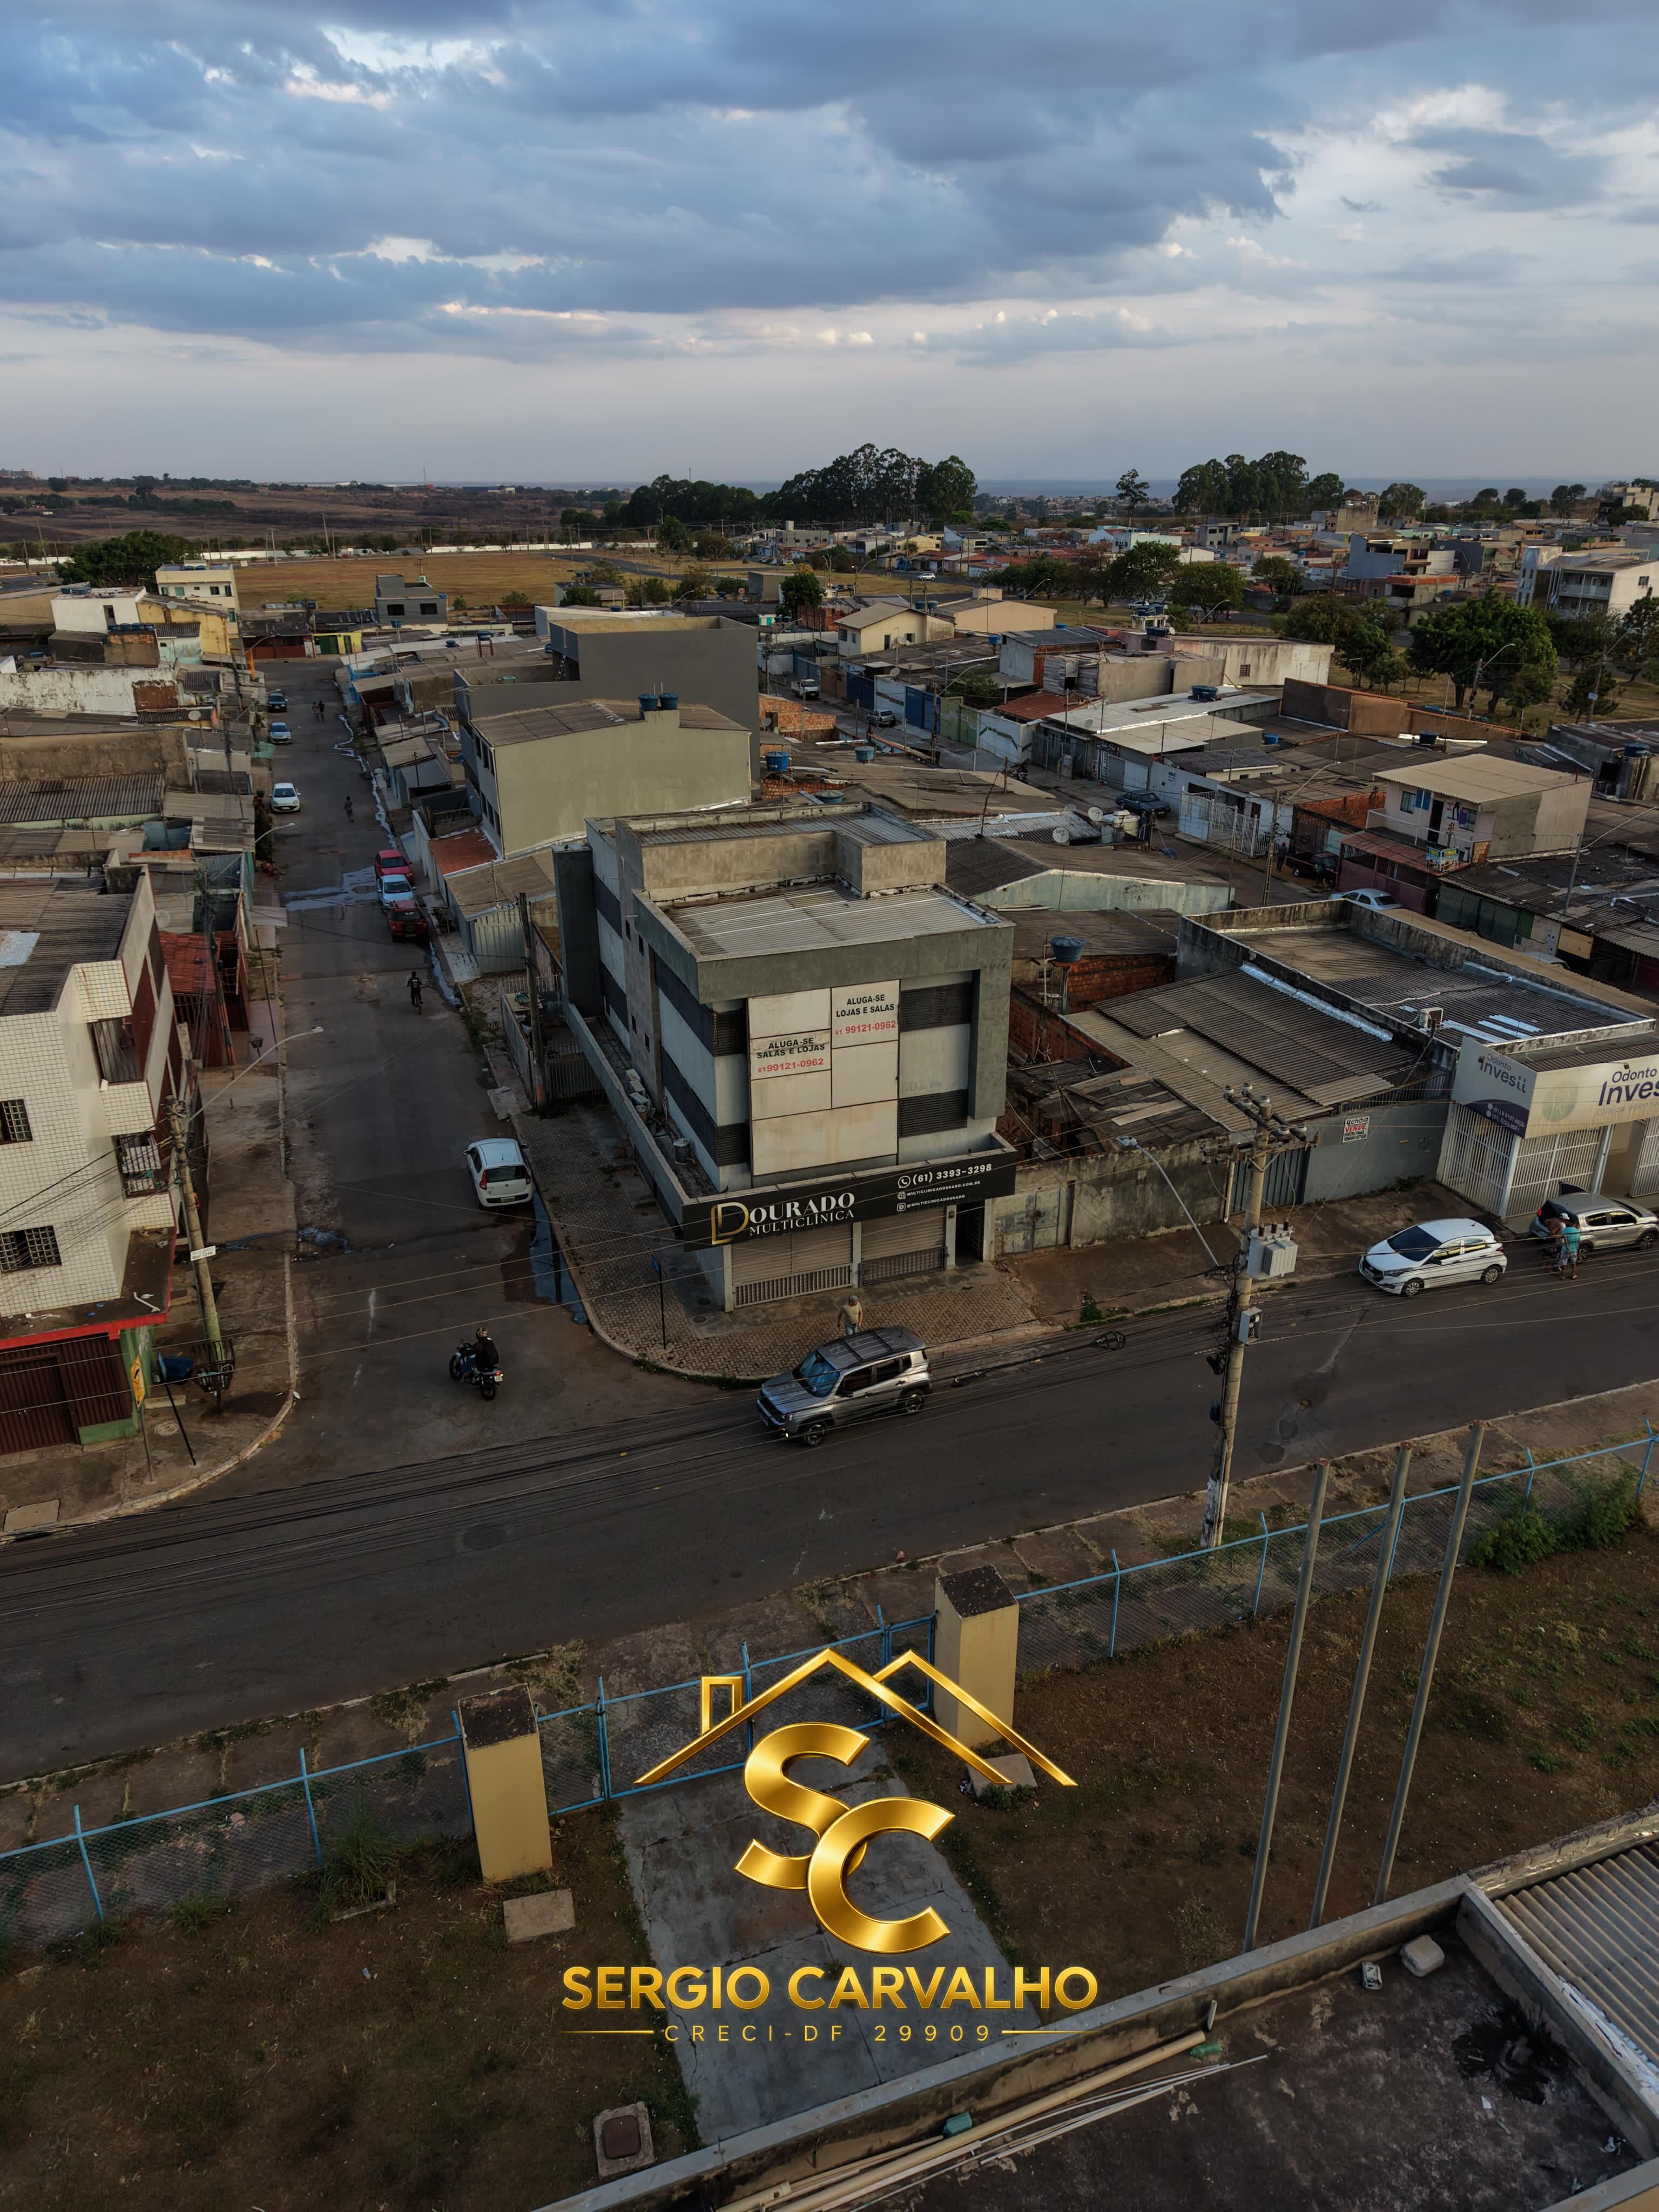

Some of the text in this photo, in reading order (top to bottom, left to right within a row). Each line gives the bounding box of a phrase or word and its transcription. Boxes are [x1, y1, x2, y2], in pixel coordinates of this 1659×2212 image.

[846, 994, 885, 1005] ALUGA-SE
[836, 1008, 860, 1017] LOJAS
[870, 1003, 894, 1013] SALAS
[845, 1020, 896, 1034] 99121-0962
[768, 1037, 814, 1049] ALUGA-SE
[757, 1050, 785, 1059] SALAS
[797, 1044, 825, 1053] LOJAS
[767, 1058, 824, 1072] 99121-0962
[1487, 1054, 1512, 1071] Odonto
[1612, 1067, 1657, 1083] Odonto
[913, 1163, 992, 1185] (61) 3393-3298
[711, 1192, 855, 1245] DOURADO
[750, 1209, 854, 1236] MULTICLÍNICA
